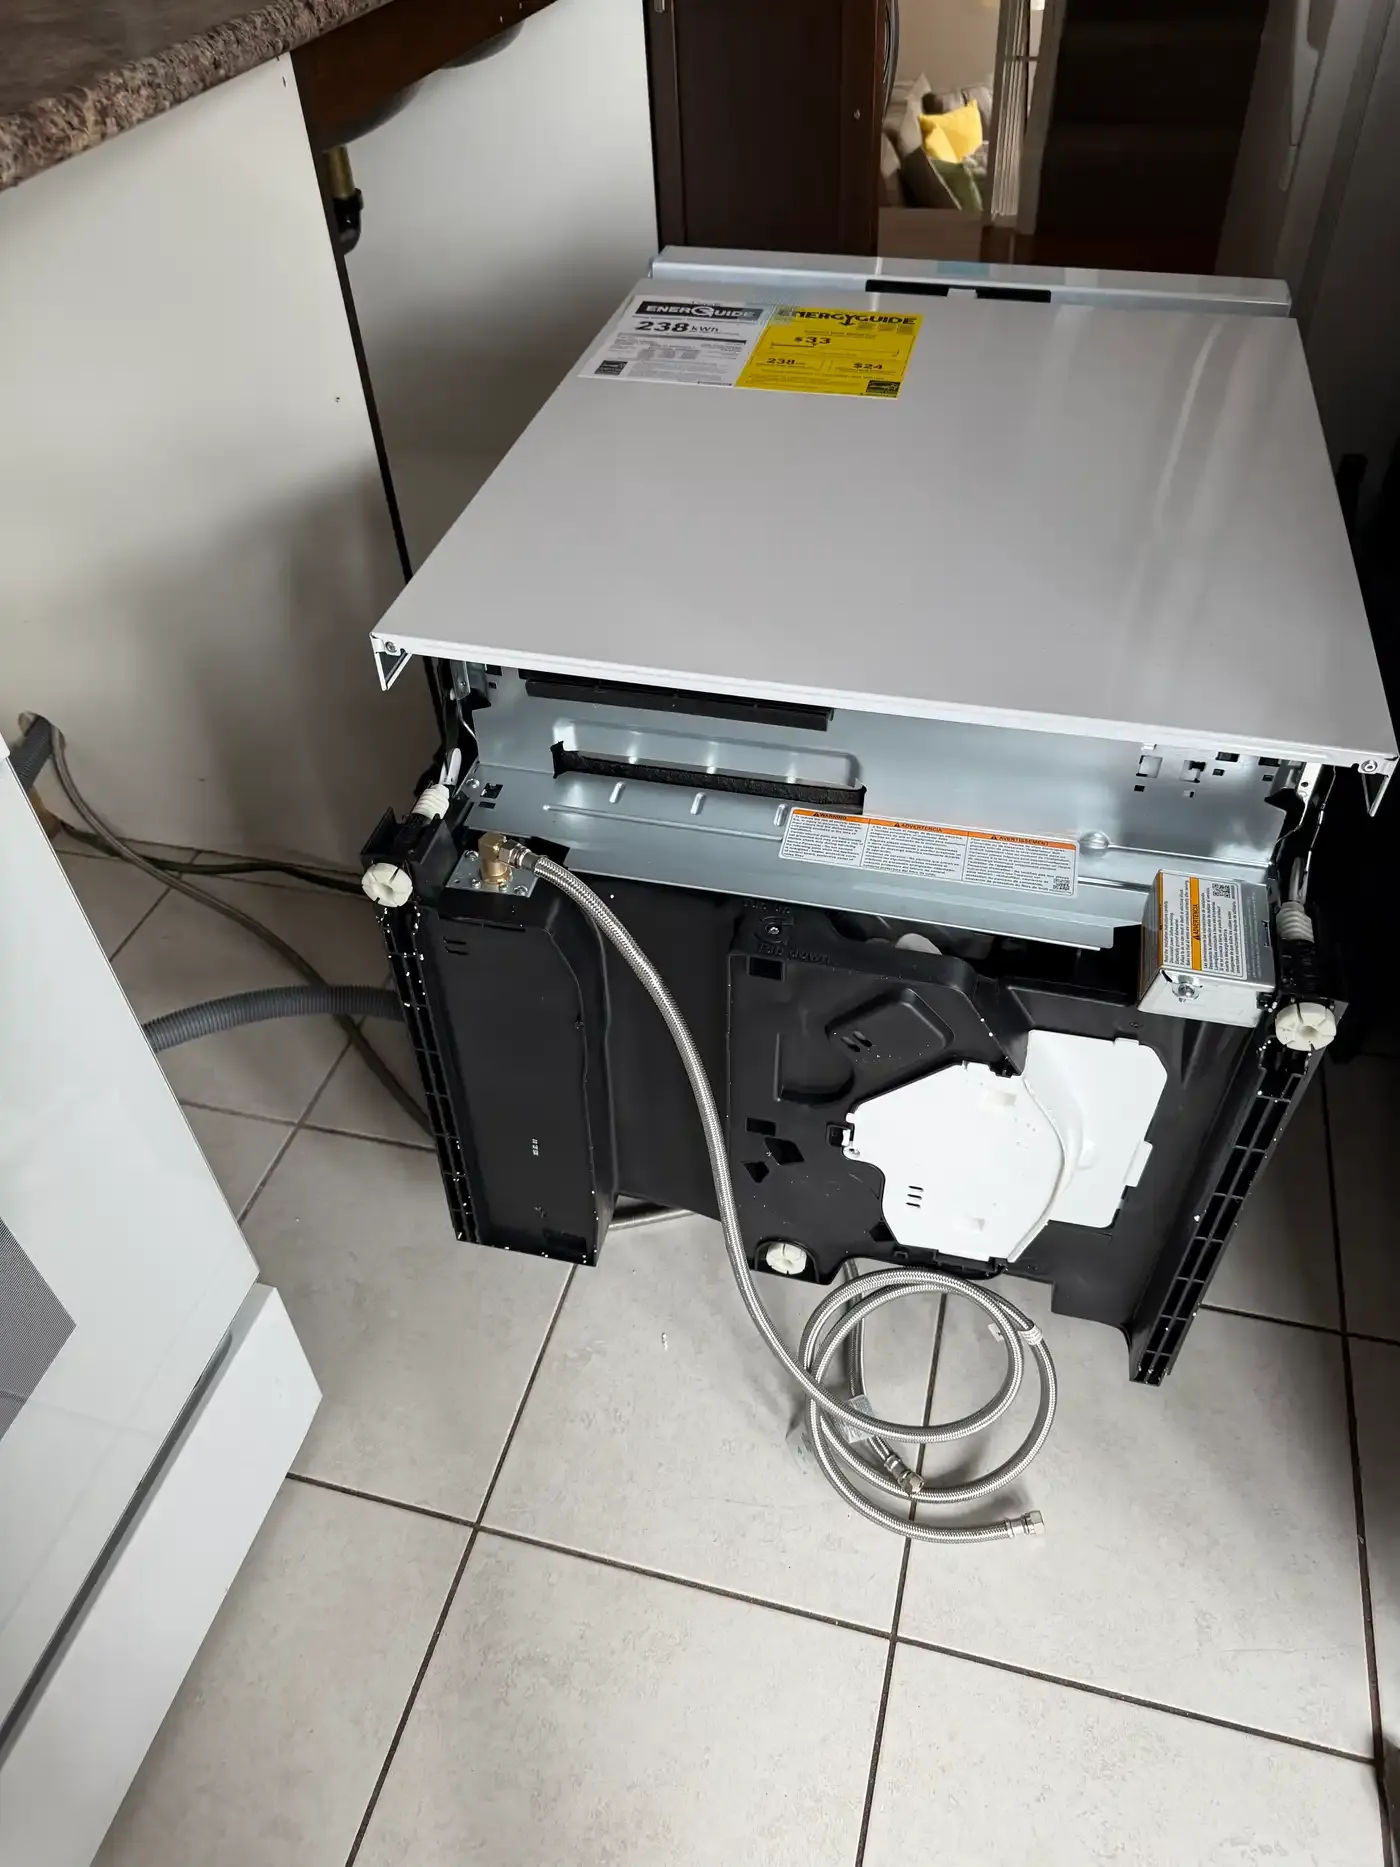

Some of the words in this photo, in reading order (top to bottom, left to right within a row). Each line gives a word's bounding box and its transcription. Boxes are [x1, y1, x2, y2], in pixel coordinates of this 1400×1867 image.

[634, 320, 690, 333] 238
[691, 325, 719, 333] kWh
[794, 336, 831, 345] $33
[853, 362, 883, 370] $24
[819, 813, 847, 821] WARNING
[901, 822, 943, 833] ADVERTENCIA
[999, 835, 1050, 847] AVERTISSEMENT
